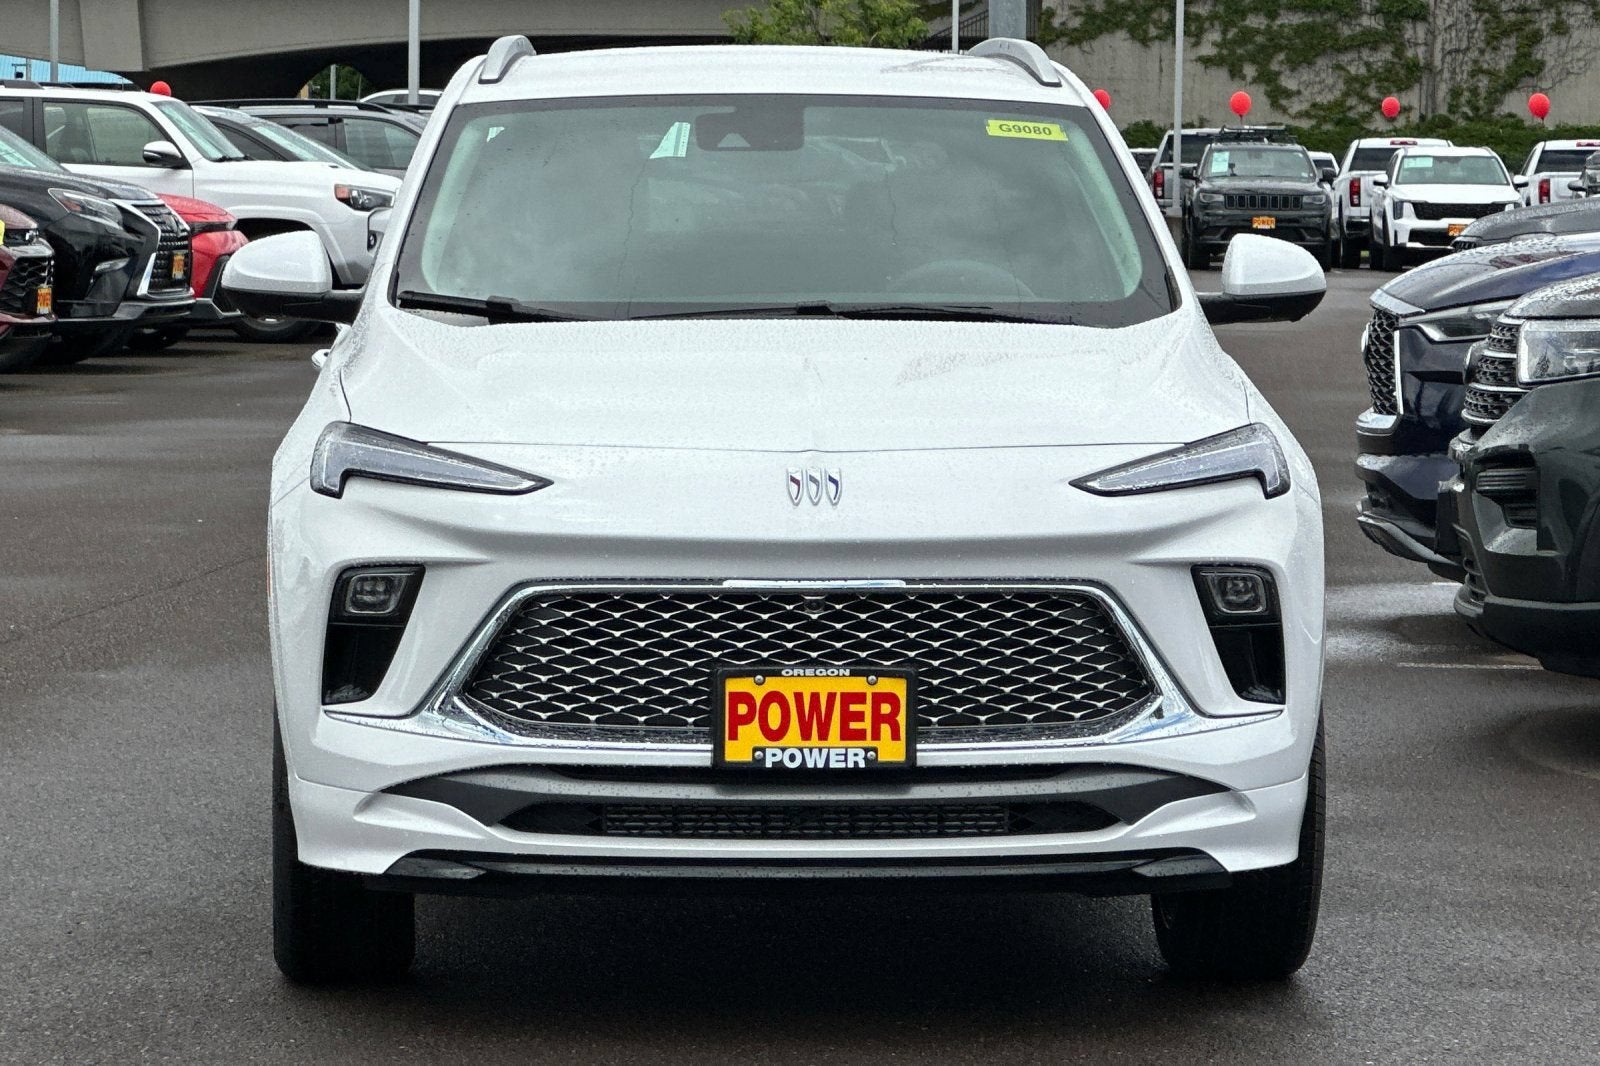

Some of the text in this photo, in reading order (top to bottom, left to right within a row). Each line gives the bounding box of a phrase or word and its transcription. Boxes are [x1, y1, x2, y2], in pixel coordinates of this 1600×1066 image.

[998, 123, 1051, 135] G9080
[781, 668, 850, 676] OREGON
[728, 690, 901, 742] POWER
[765, 748, 866, 769] POWER
